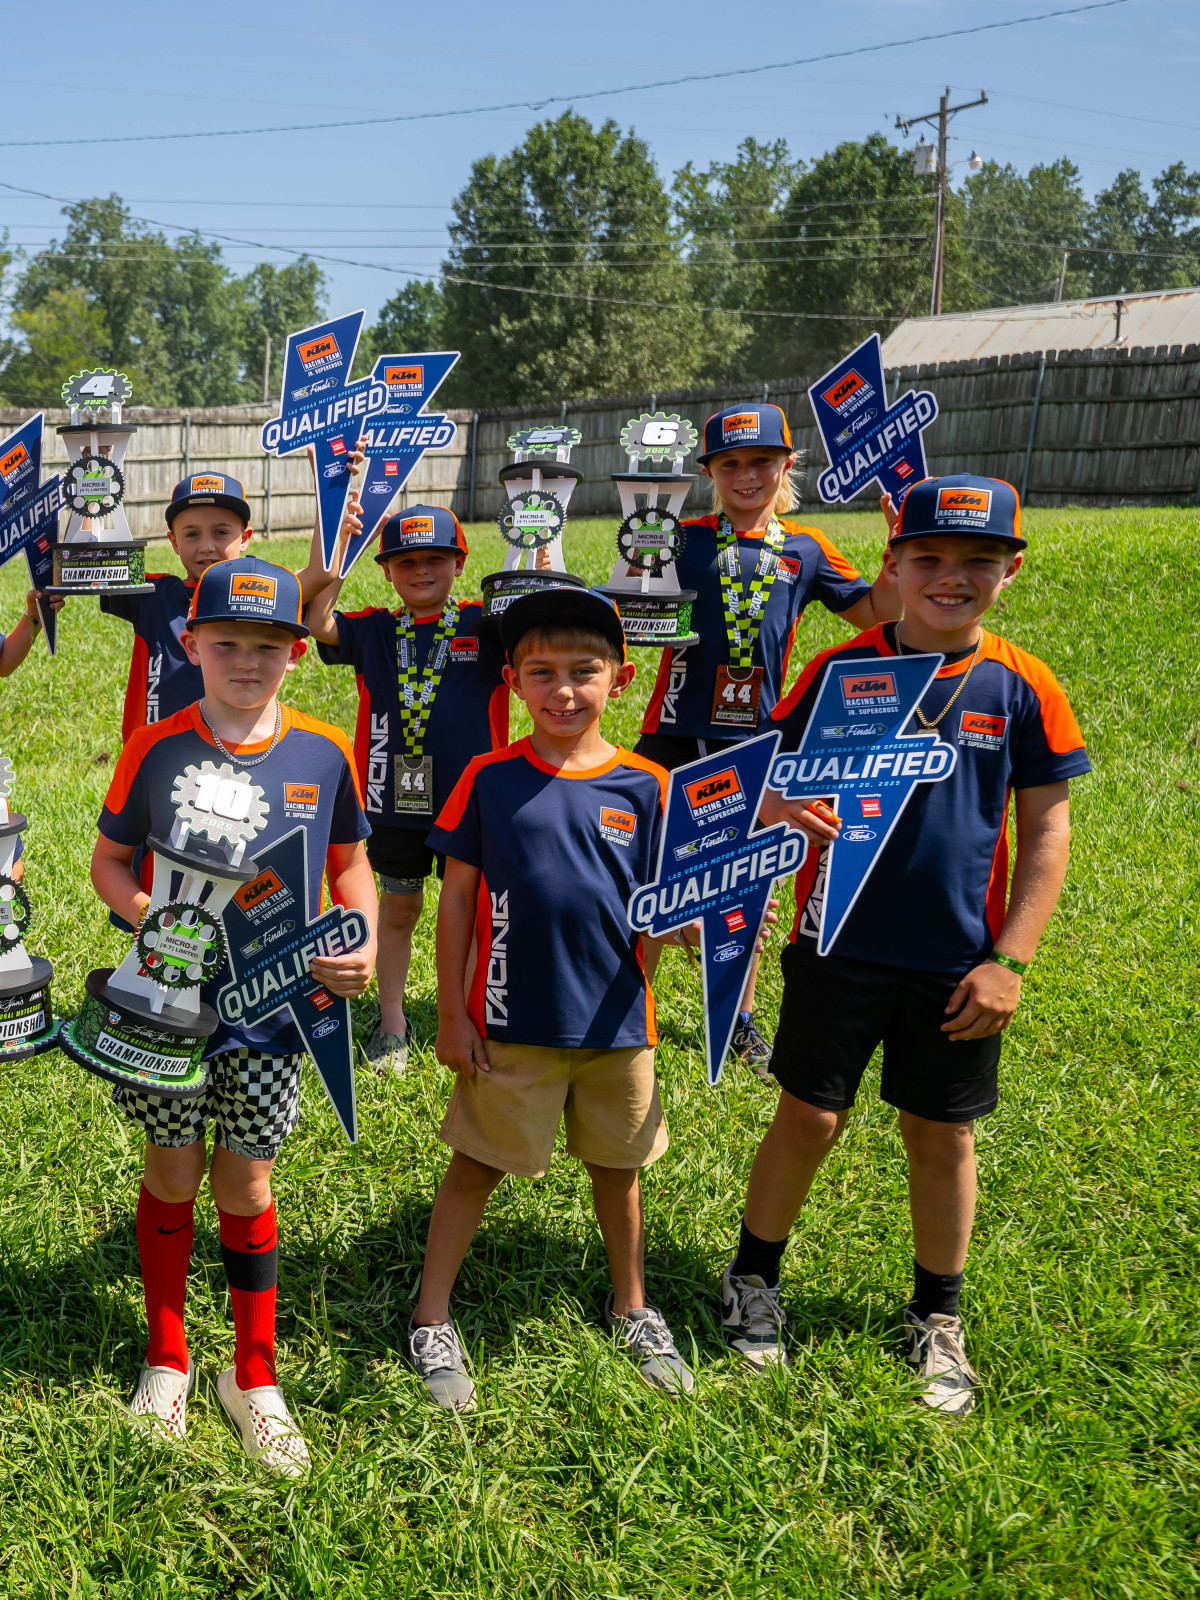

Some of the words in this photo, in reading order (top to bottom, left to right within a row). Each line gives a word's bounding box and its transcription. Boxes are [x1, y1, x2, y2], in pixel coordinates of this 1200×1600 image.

[307, 342, 331, 357] KTM
[304, 357, 325, 370] RACING
[325, 351, 340, 362] TEAM
[391, 371, 417, 380] KTM
[80, 376, 114, 397] 4
[833, 378, 857, 401] KTM
[836, 394, 856, 413] RACING
[854, 383, 870, 397] TEAM
[267, 387, 383, 447] QUALIFIED
[642, 421, 679, 446] 6
[823, 397, 932, 498] QUALIFIED
[4, 450, 22, 471] KTM
[946, 494, 982, 505] KTM
[948, 520, 986, 528] SUPERCROSS
[968, 510, 987, 518] TEAM
[62, 568, 127, 582] CHAMPIONSHIP
[238, 580, 270, 592] KTM
[240, 605, 272, 616] SUPERCROSS
[258, 596, 274, 606] TEAM
[419, 680, 434, 705] 2025
[722, 683, 752, 704] 44
[851, 680, 887, 692] KTM
[846, 697, 874, 706] RACING
[876, 696, 897, 704] TEAM
[858, 706, 899, 715] SUPERCROSS
[846, 723, 876, 737] Finals
[773, 750, 948, 785] QUALIFIED
[400, 772, 426, 792] 44
[697, 778, 730, 801] KTM
[194, 774, 253, 822] 10
[291, 788, 314, 799] KTM
[693, 800, 721, 818] RACING
[722, 791, 743, 806] TEAM
[697, 818, 707, 827] JR.
[707, 802, 746, 823] SUPERCROSS
[201, 815, 234, 832] 2025
[606, 814, 631, 826] KTM
[700, 828, 728, 852] Finals
[849, 830, 869, 840] Ford
[668, 871, 682, 881] LAS
[685, 861, 708, 875] VEGAS
[714, 850, 735, 863] MOTOR
[738, 834, 775, 855] SPEEDWAY
[243, 878, 274, 904] KTM
[637, 838, 800, 924] QUALIFIED
[245, 898, 271, 919] RACING
[269, 887, 289, 903] TEAM
[252, 917, 263, 926] JR.
[261, 896, 295, 921] SUPERCROSS
[668, 900, 716, 923] SEPTEMBER
[739, 883, 759, 896] 2025
[165, 936, 198, 951] MICRO-E
[719, 946, 739, 960] Ford
[224, 917, 362, 1019] QUALIFIED
[100, 1036, 188, 1074] CHAMPIONSHIP
